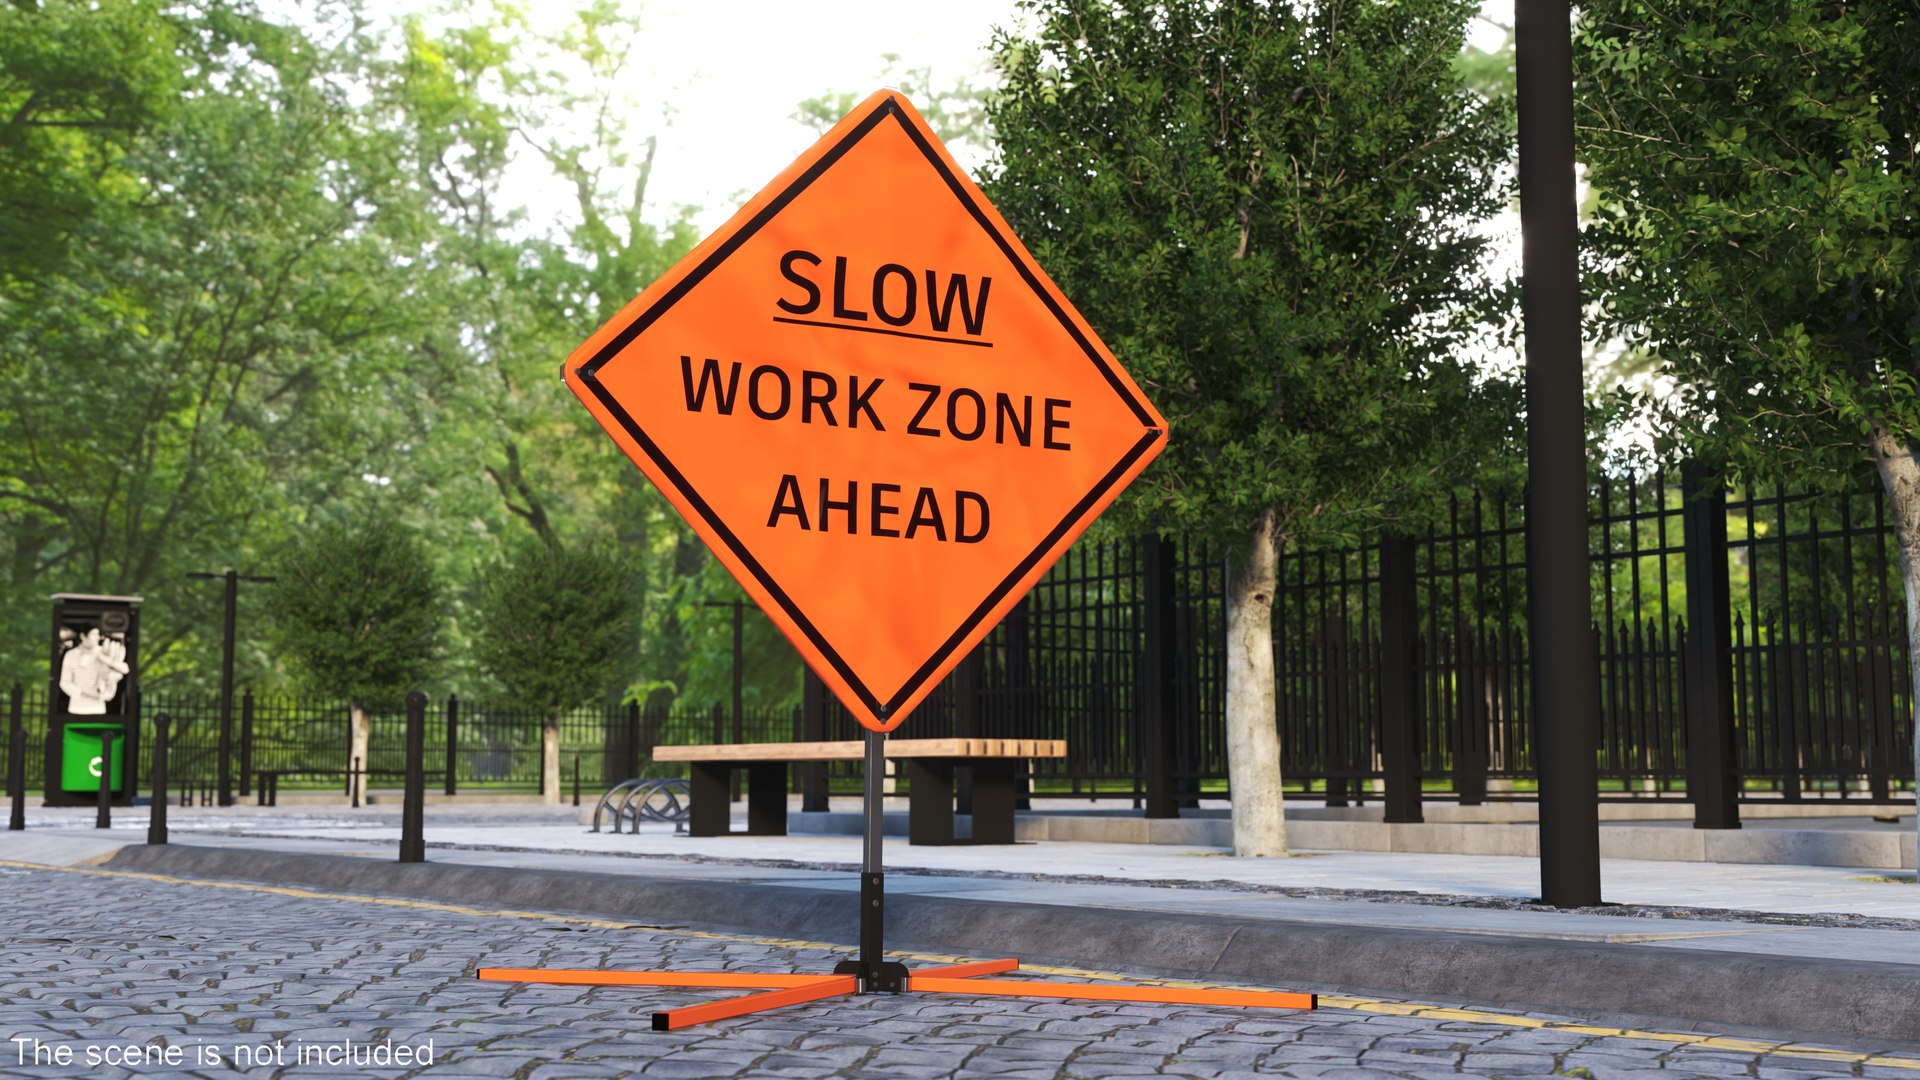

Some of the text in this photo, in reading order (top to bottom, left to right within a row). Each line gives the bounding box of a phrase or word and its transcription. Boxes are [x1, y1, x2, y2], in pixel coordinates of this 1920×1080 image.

[776, 249, 992, 336] SLOW
[680, 355, 1072, 451] WORK ZONE
[766, 474, 990, 544] AHEAD
